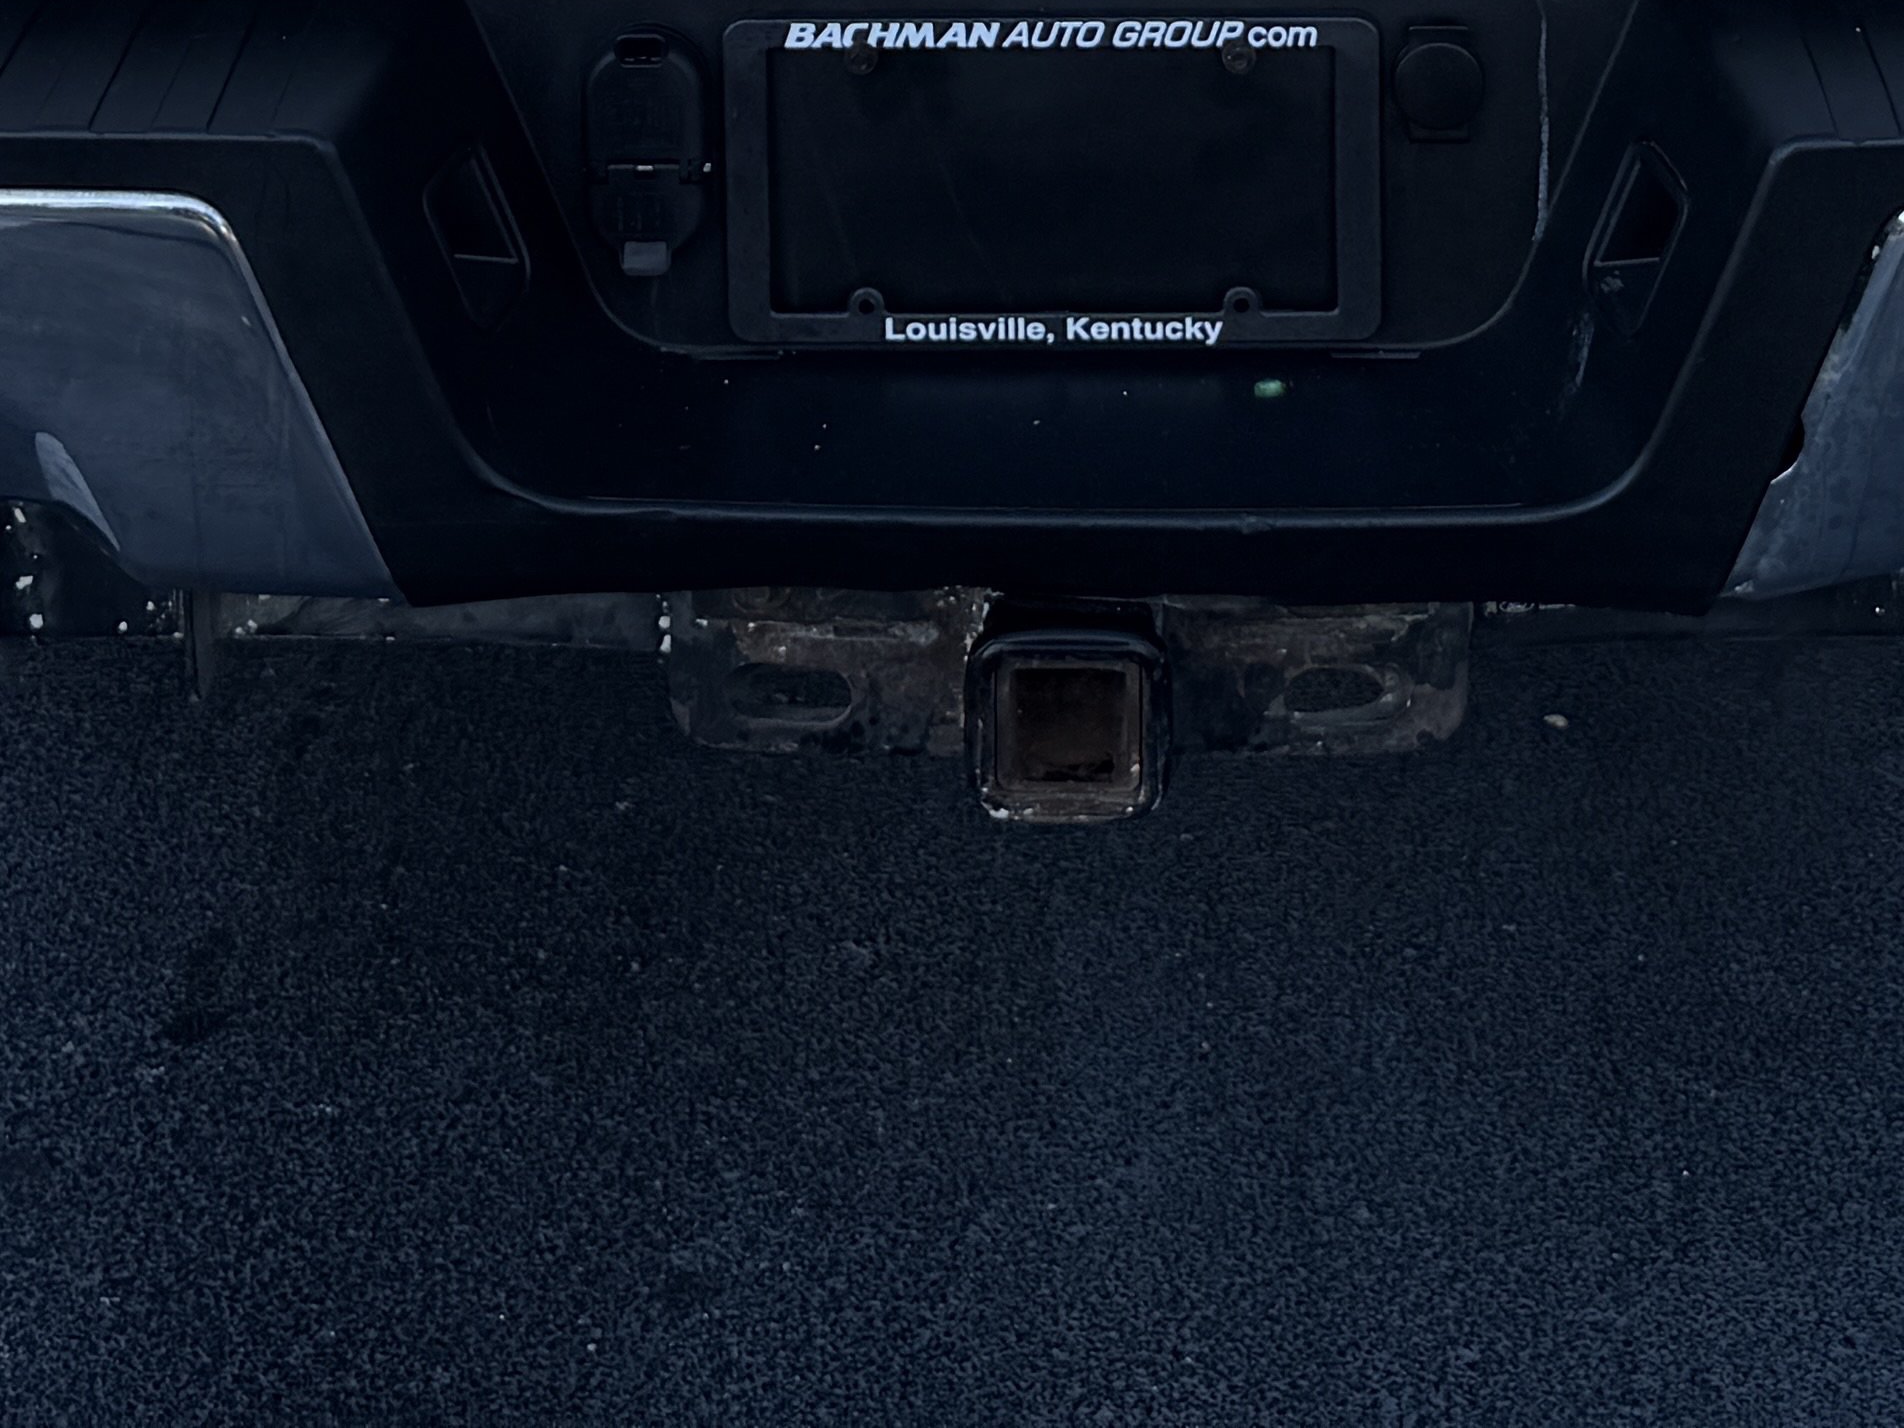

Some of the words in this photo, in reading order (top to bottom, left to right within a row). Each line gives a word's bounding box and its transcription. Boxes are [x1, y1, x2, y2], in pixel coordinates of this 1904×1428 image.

[784, 22, 1000, 48] BACHMAN
[1003, 21, 1105, 48] AUTO
[885, 317, 1055, 344] Louisville,
[1066, 316, 1223, 345] Kentucky
